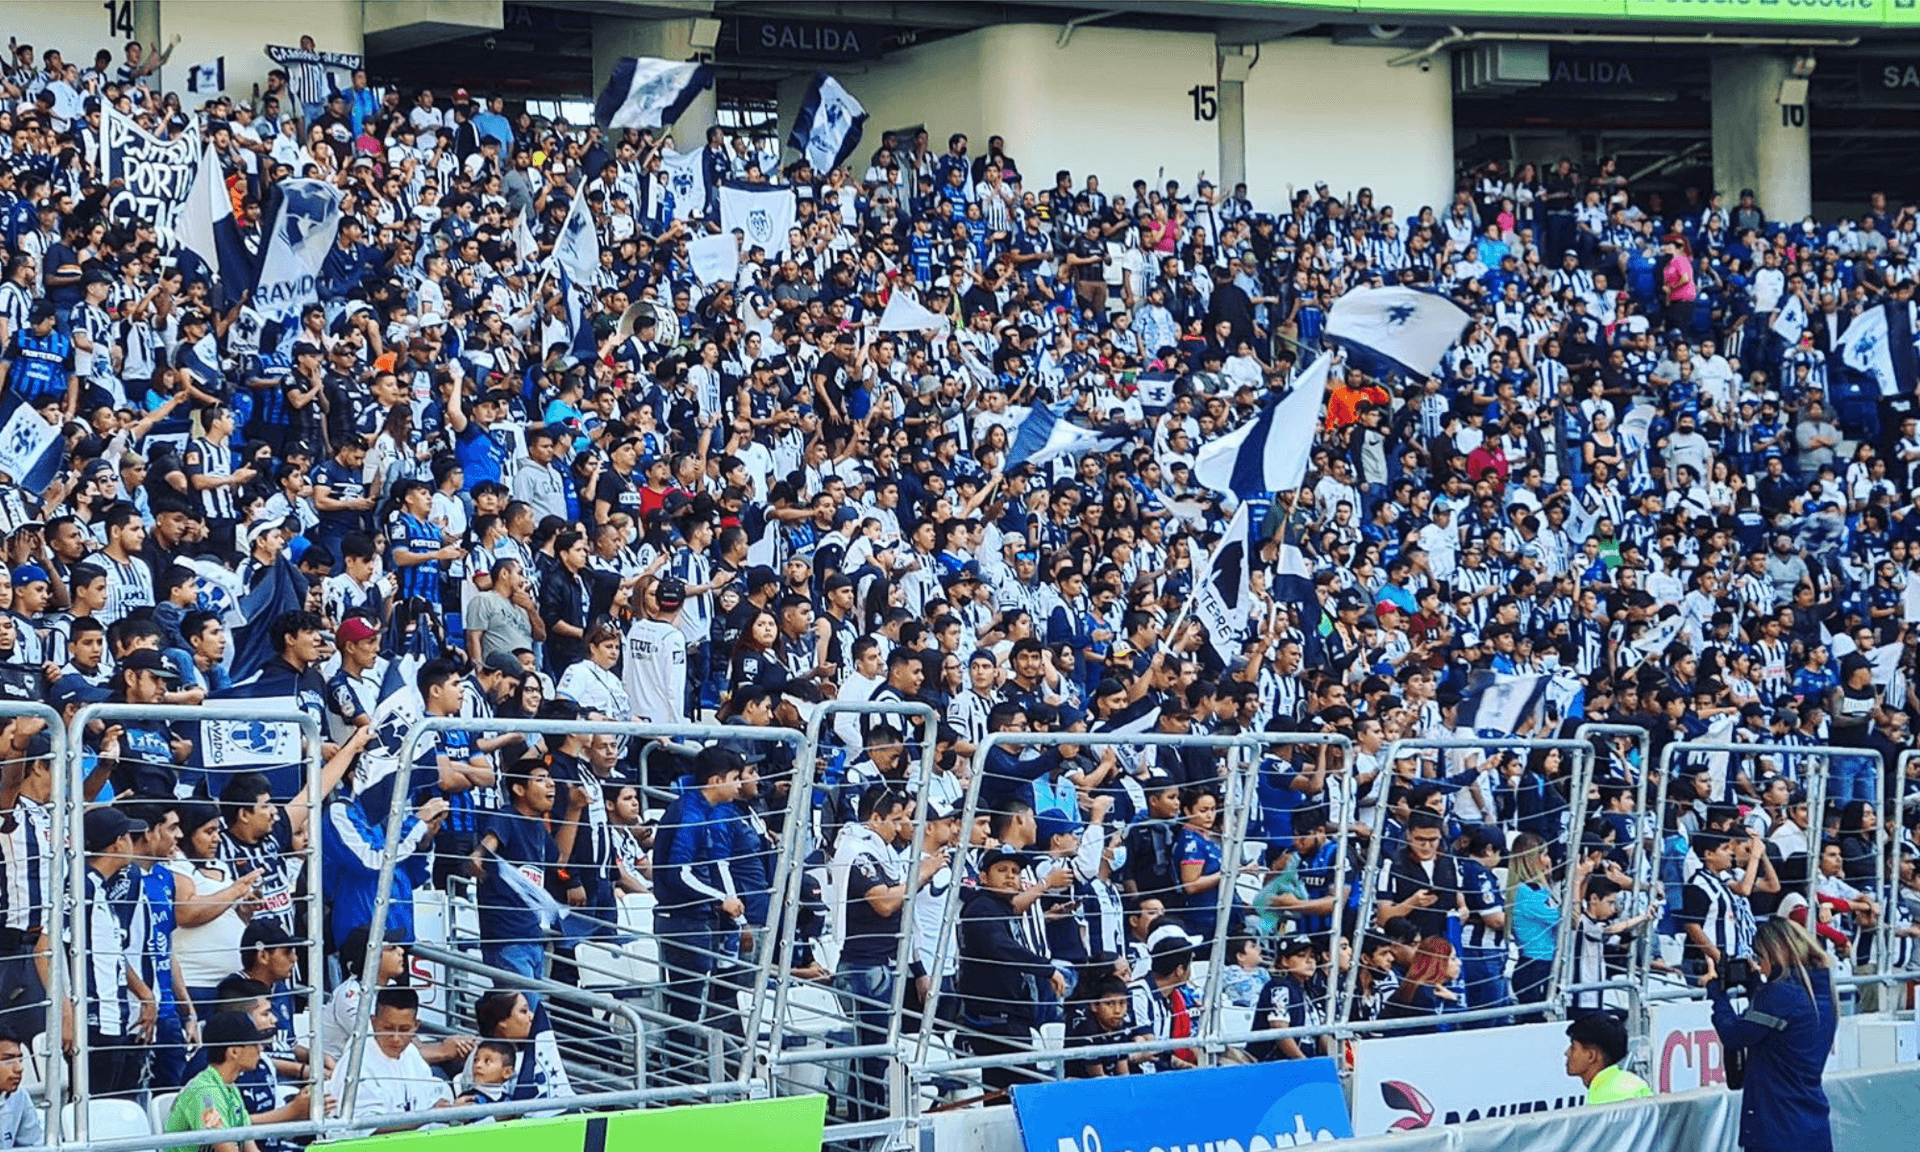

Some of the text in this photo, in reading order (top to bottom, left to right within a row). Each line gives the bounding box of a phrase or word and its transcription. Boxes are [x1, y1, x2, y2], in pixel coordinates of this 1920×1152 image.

[104, 0, 133, 39] 14
[761, 24, 860, 51] SALIDA
[1553, 61, 1634, 84] ALIDA
[1882, 65, 1920, 88] SA
[1188, 84, 1217, 121] 15
